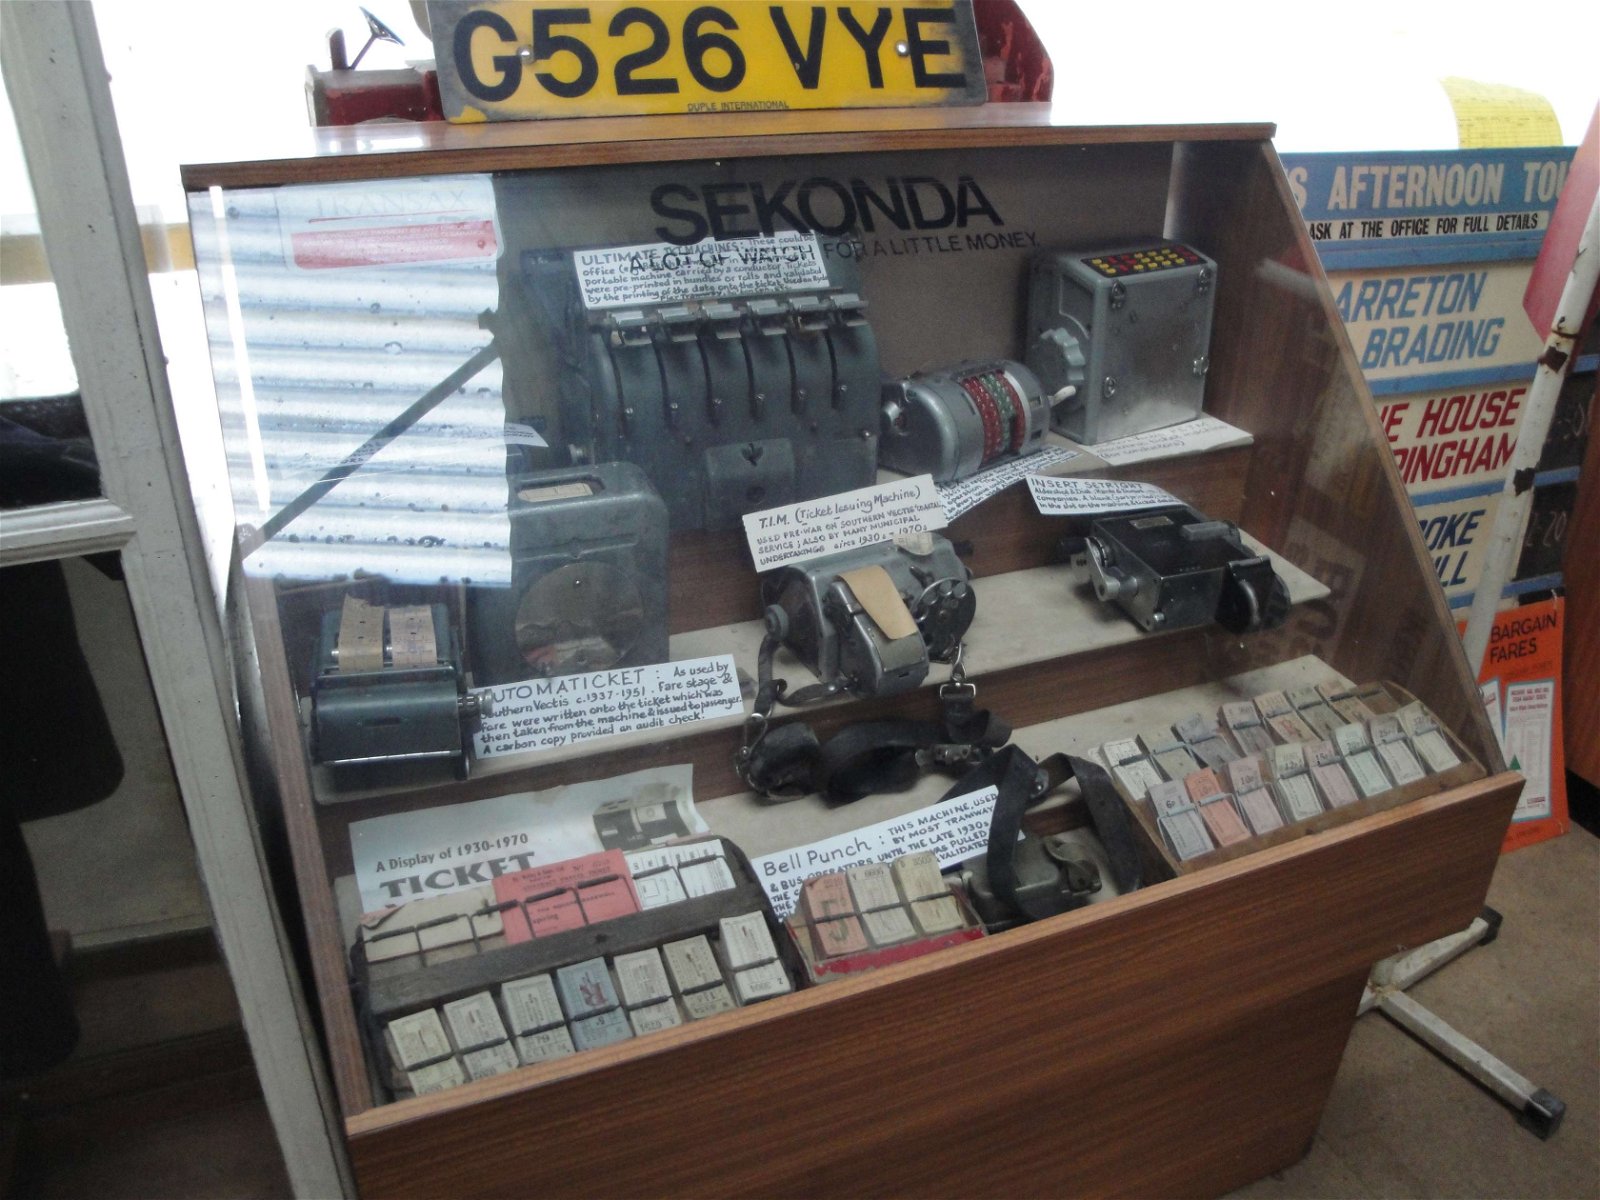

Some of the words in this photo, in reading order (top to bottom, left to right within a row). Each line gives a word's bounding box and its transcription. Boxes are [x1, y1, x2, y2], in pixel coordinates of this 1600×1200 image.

[451, 6, 747, 103] G526
[770, 6, 968, 90] VYE
[687, 103, 717, 113] DUPLE
[720, 101, 790, 112] INTERNATIONAL
[1327, 163, 1505, 210] AFTERNOON
[650, 176, 1004, 247] SEKONDA
[1309, 221, 1333, 240] ASK
[1339, 221, 1354, 238] AT
[1361, 220, 1384, 238] THE
[1391, 217, 1430, 236] OFFICE
[1436, 216, 1458, 234] FOR
[1463, 215, 1489, 232] FULL
[1496, 213, 1538, 231] DETAILS
[581, 249, 661, 266] ULTIMATE
[823, 241, 865, 260] FOR
[873, 240, 889, 257] A
[892, 234, 963, 256] LITTLE
[582, 267, 616, 277] office
[584, 277, 629, 288] portable
[675, 266, 711, 277] carried
[786, 260, 817, 270] Tickets
[612, 279, 671, 295] pre-printed
[673, 277, 682, 285] in
[684, 274, 722, 285] bundles
[738, 273, 760, 281] rolls
[764, 271, 781, 280] and
[588, 294, 602, 305] by
[603, 292, 620, 301] the
[622, 290, 659, 302] printing
[672, 286, 689, 295] the
[1361, 317, 1505, 369] BRADING
[1416, 388, 1526, 439] HOUSE
[1030, 478, 1078, 489] INSERT
[1084, 481, 1143, 490] SETRIGHT
[756, 533, 782, 546] USED
[840, 511, 886, 530] SOUTHERN
[758, 514, 791, 529] T.I.M.
[794, 505, 833, 524] (Ticket
[834, 498, 873, 515] Issuing
[1419, 509, 1487, 551] OKE
[758, 542, 794, 554] SERVICE
[803, 534, 826, 546] ALSO
[828, 531, 841, 541] BY
[843, 525, 868, 538] MANY
[869, 514, 921, 533] MUNICIPAL
[1490, 612, 1557, 644] BARGAIN
[1490, 637, 1537, 664] FARES
[492, 668, 646, 703] UTOMATICKET
[673, 667, 688, 677] As
[690, 664, 716, 675] used
[716, 661, 730, 679] by
[533, 696, 569, 710] Vectis
[686, 677, 718, 693] stage
[722, 673, 733, 684] &
[480, 731, 511, 744] then
[513, 724, 548, 739] taken
[547, 720, 575, 734] from
[575, 717, 595, 730] the
[596, 710, 647, 726] machine
[647, 707, 656, 719] &
[656, 703, 689, 717] issued
[689, 701, 700, 713] to
[481, 721, 508, 735] fare
[511, 717, 538, 729] were
[543, 708, 587, 724] written
[589, 704, 617, 716] onto
[617, 700, 637, 712] the
[638, 695, 671, 710] ticket
[672, 692, 704, 704] which
[704, 687, 724, 698] was
[483, 743, 492, 754] A
[495, 738, 538, 753] carbon
[540, 733, 567, 749] copy
[570, 724, 616, 743] provided
[619, 721, 633, 732] an
[636, 716, 665, 730] audit
[763, 852, 801, 876] Bell
[806, 836, 872, 865] Punch
[888, 821, 914, 836] THIS
[973, 793, 997, 807] USED
[892, 835, 906, 845] BY
[909, 822, 941, 840] MOST
[945, 805, 994, 827] TRAMWAY
[949, 830, 988, 848] PULLED
[376, 861, 386, 873] A
[389, 851, 436, 875] Display
[438, 846, 453, 859] of
[456, 833, 529, 856] 1930-1970
[769, 882, 779, 893] &
[780, 875, 805, 891] BUS
[807, 857, 873, 880] OPERATORS
[877, 847, 906, 862] UNTIL
[908, 839, 928, 852] THE
[929, 830, 955, 845] LATE
[957, 821, 990, 835] 1930s
[939, 839, 990, 860] VALIDATED
[379, 851, 536, 898] TICKET
[770, 891, 790, 903] THE
[773, 903, 793, 913] THE
